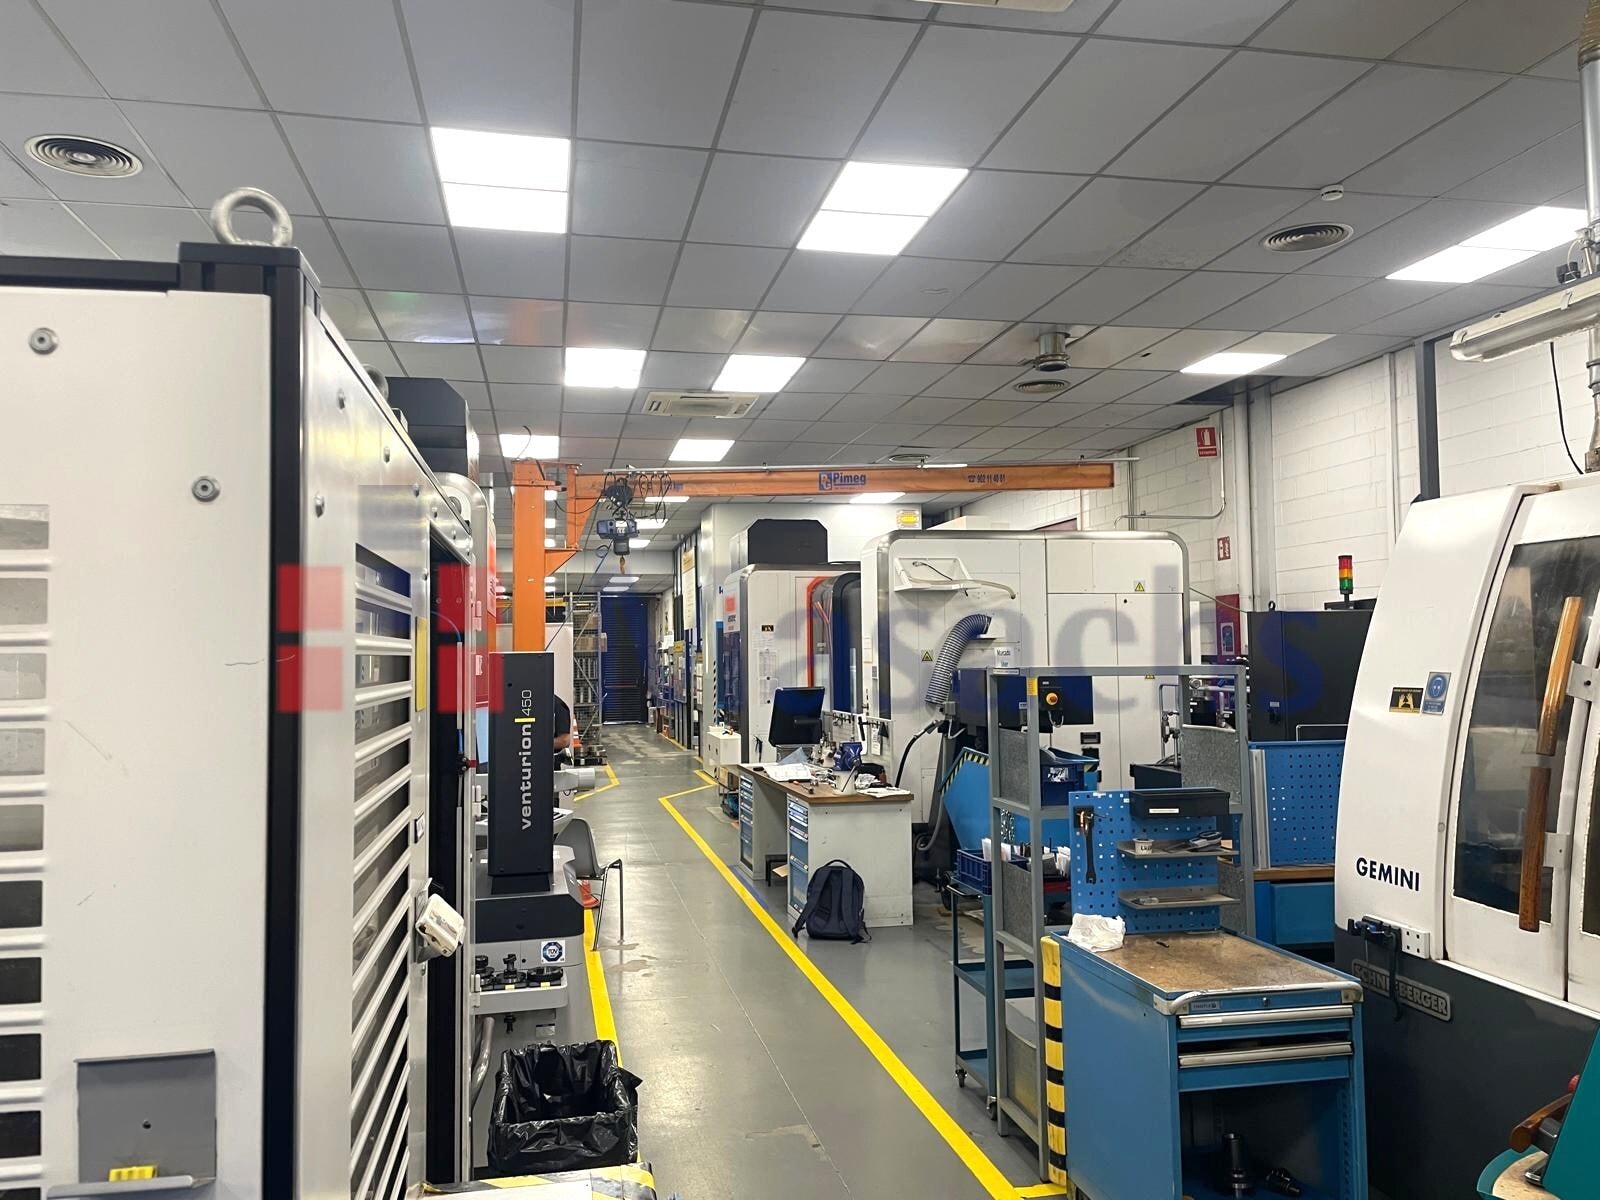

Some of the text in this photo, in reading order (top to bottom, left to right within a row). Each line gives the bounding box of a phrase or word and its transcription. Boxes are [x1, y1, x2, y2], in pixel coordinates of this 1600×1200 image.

[833, 472, 866, 486] Pimeg
[519, 689, 532, 830] venturion 450
[1356, 857, 1420, 892] GEMINI
[1353, 964, 1448, 1015] SCHNBERGER
